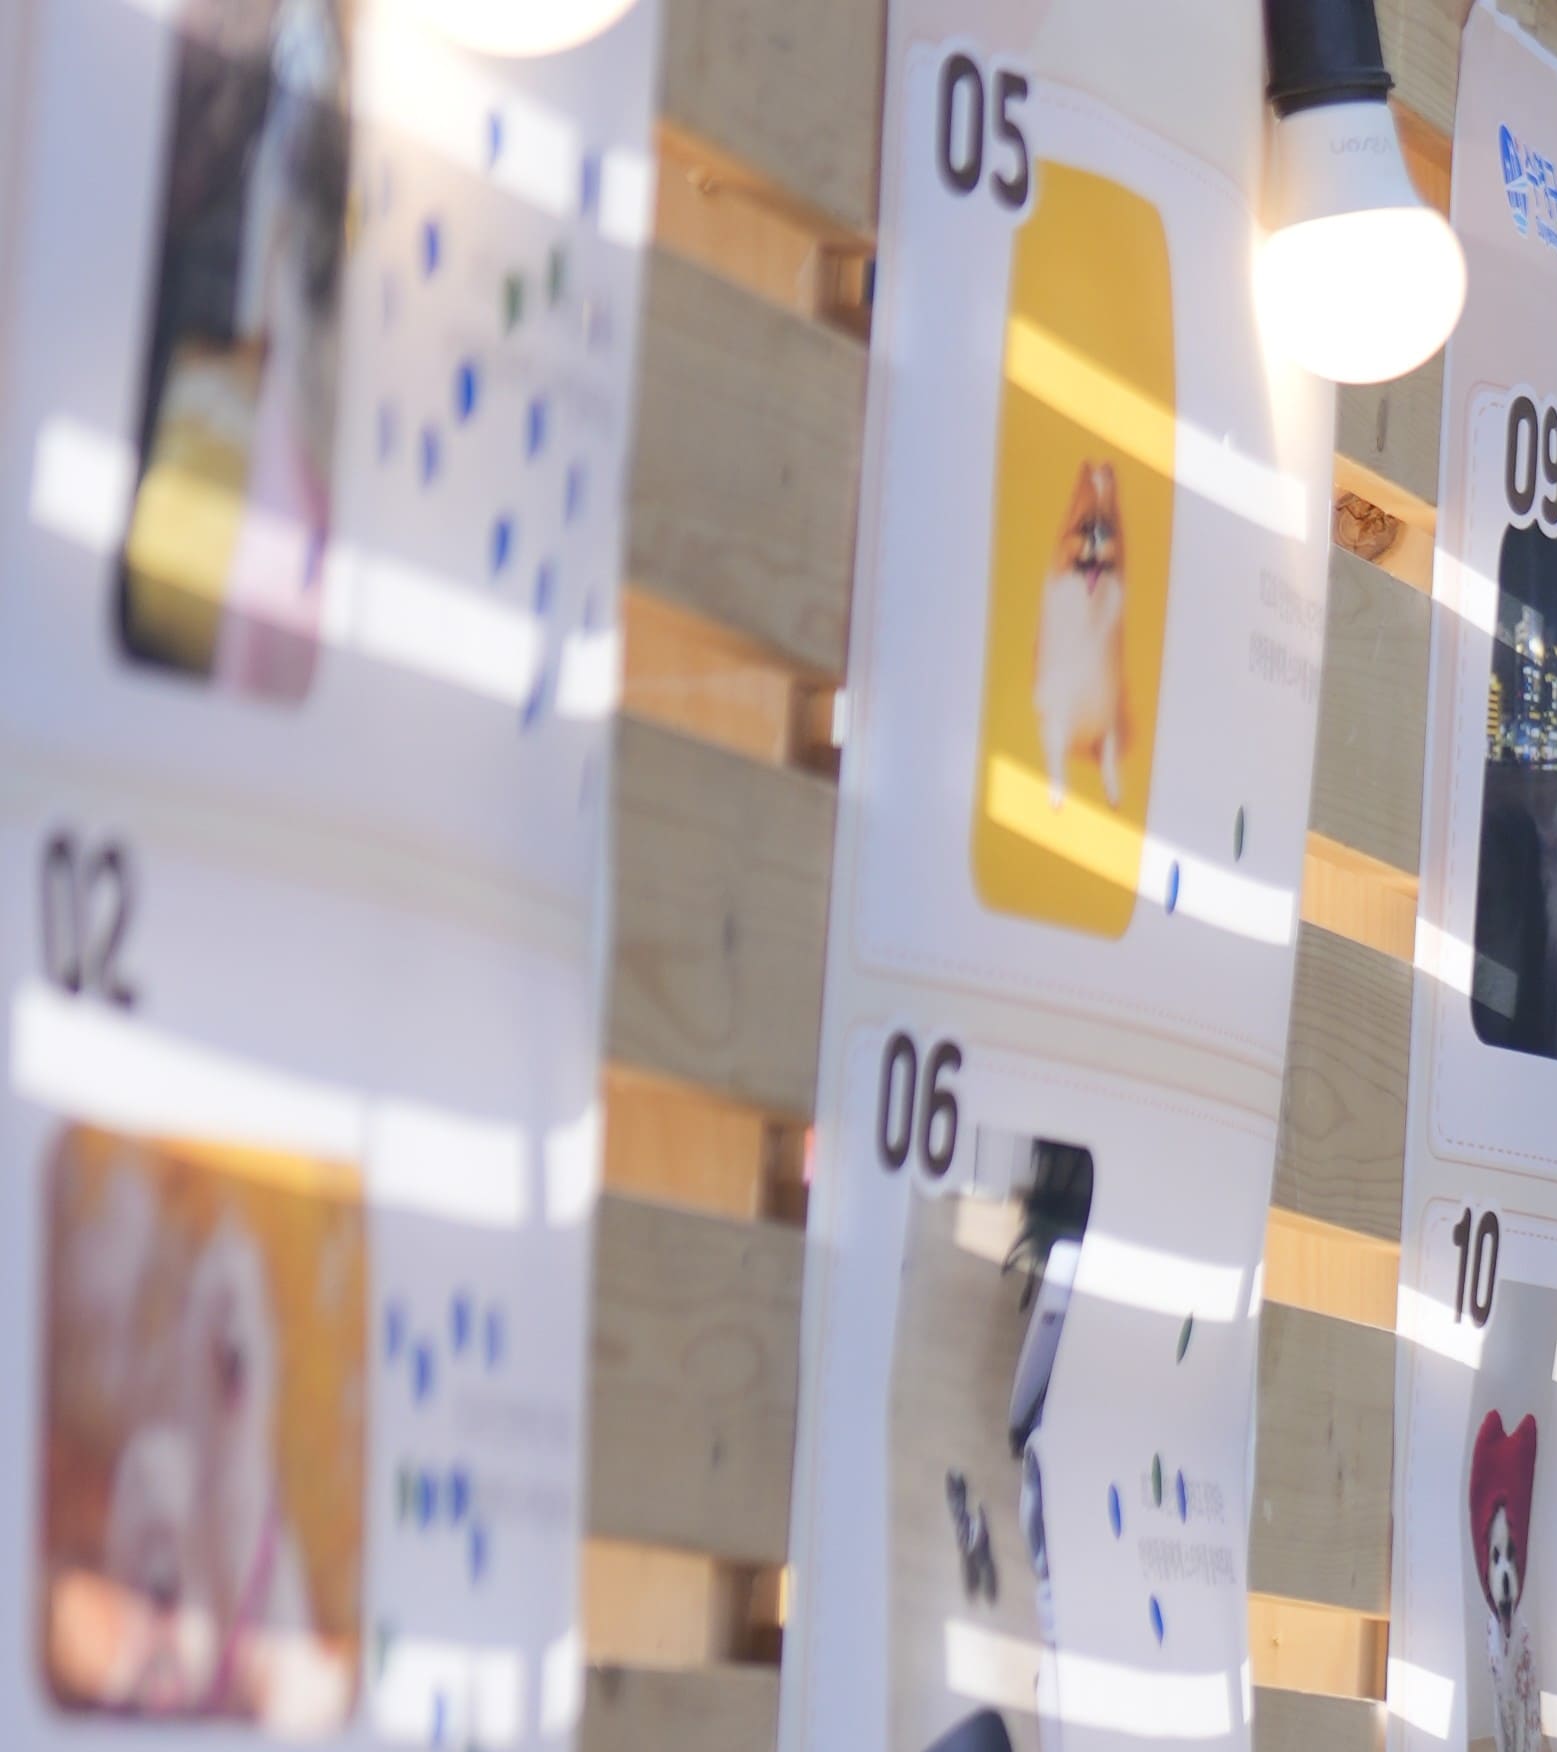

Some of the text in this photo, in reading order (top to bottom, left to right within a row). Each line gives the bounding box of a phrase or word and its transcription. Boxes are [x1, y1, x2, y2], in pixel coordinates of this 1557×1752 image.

[937, 53, 1031, 209] 05
[40, 832, 138, 1010] 02
[877, 1030, 962, 1178] 06
[1452, 1206, 1499, 1328] 10
